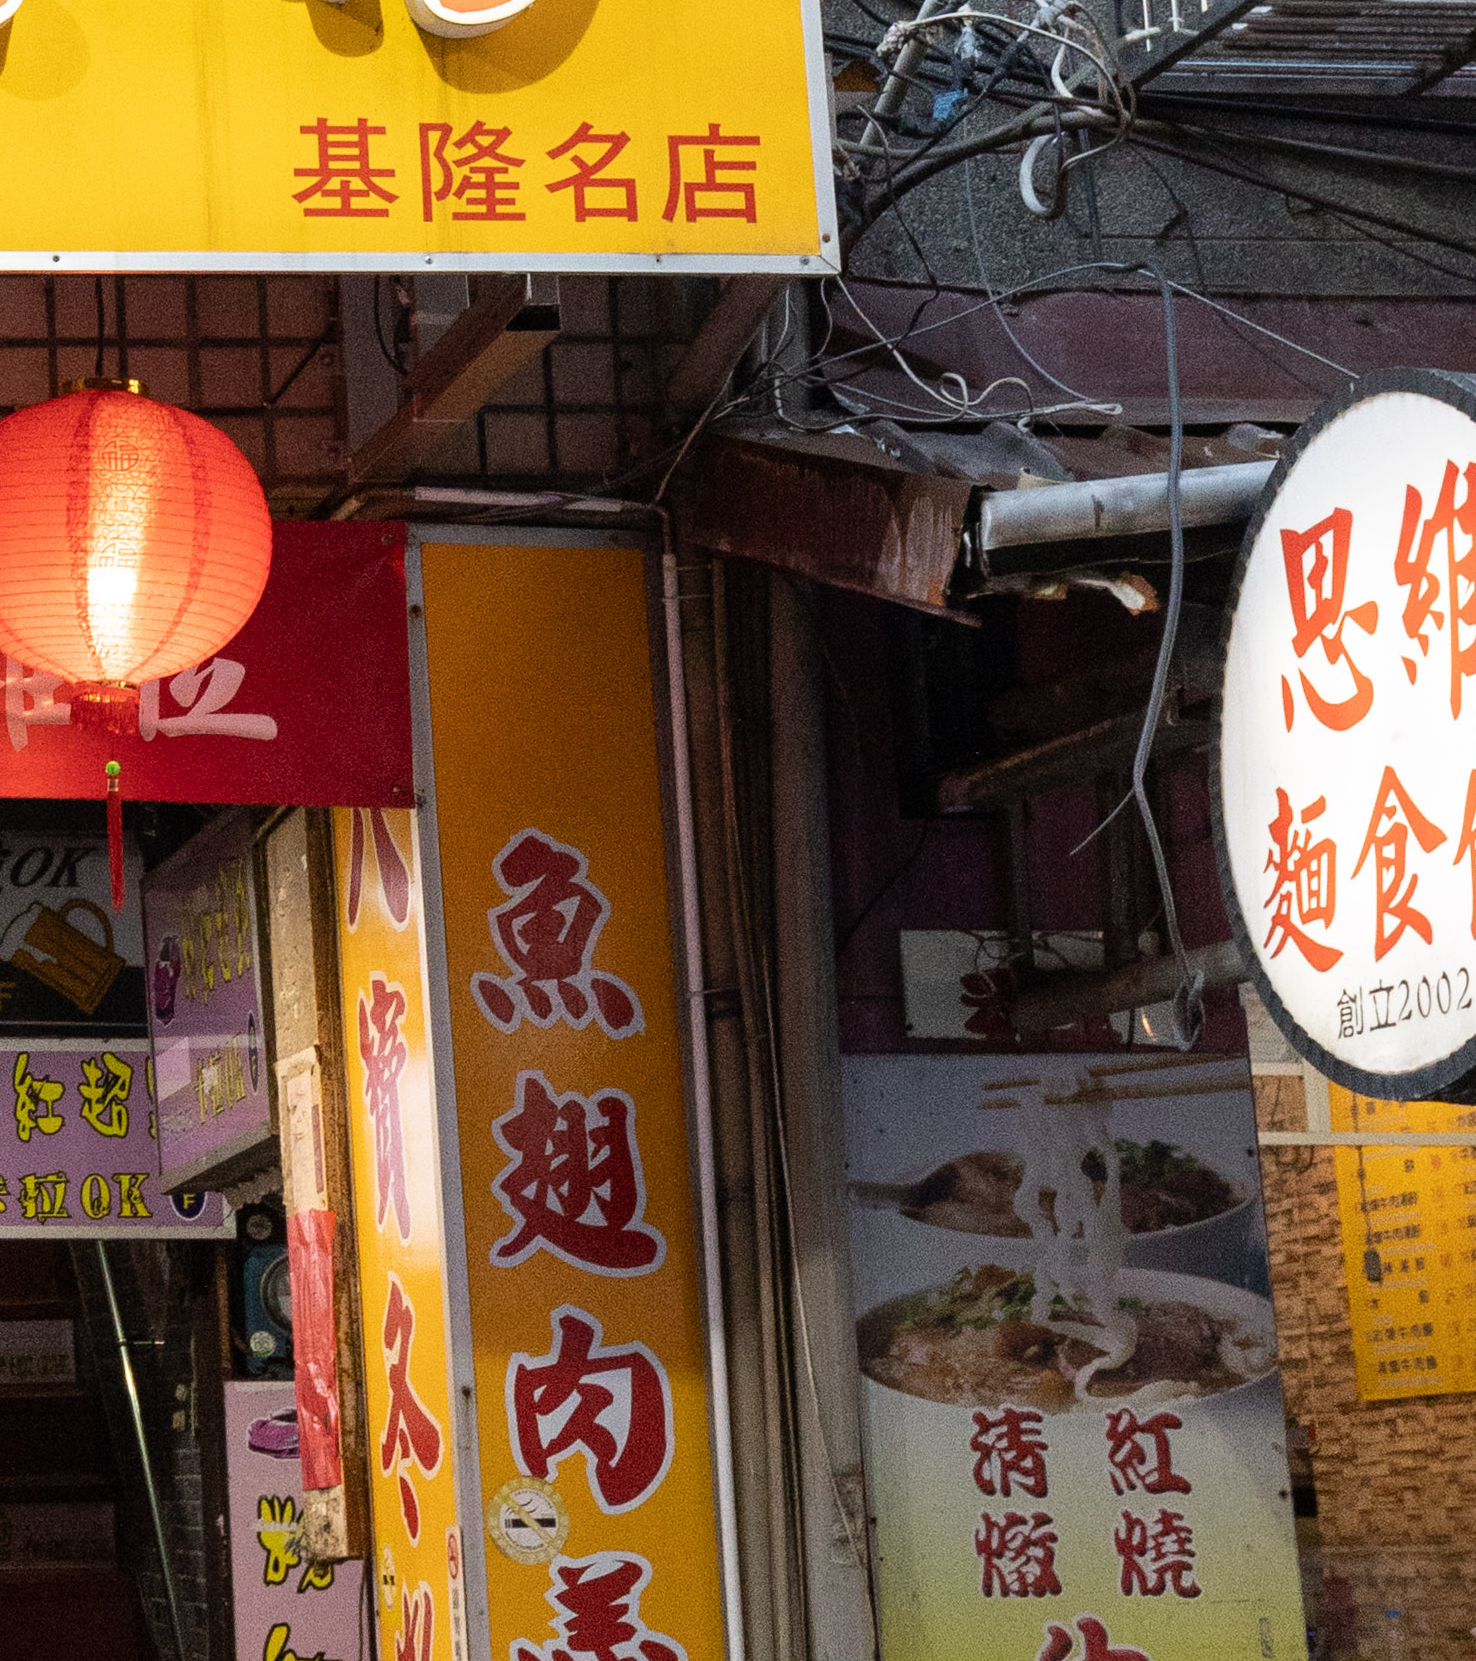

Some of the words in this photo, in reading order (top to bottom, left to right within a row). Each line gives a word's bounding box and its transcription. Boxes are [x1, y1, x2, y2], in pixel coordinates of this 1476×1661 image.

[291, 118, 761, 229] 基隆名店
[1263, 764, 1476, 975] 麵食
[1105, 1406, 1203, 1599] 紅燒
